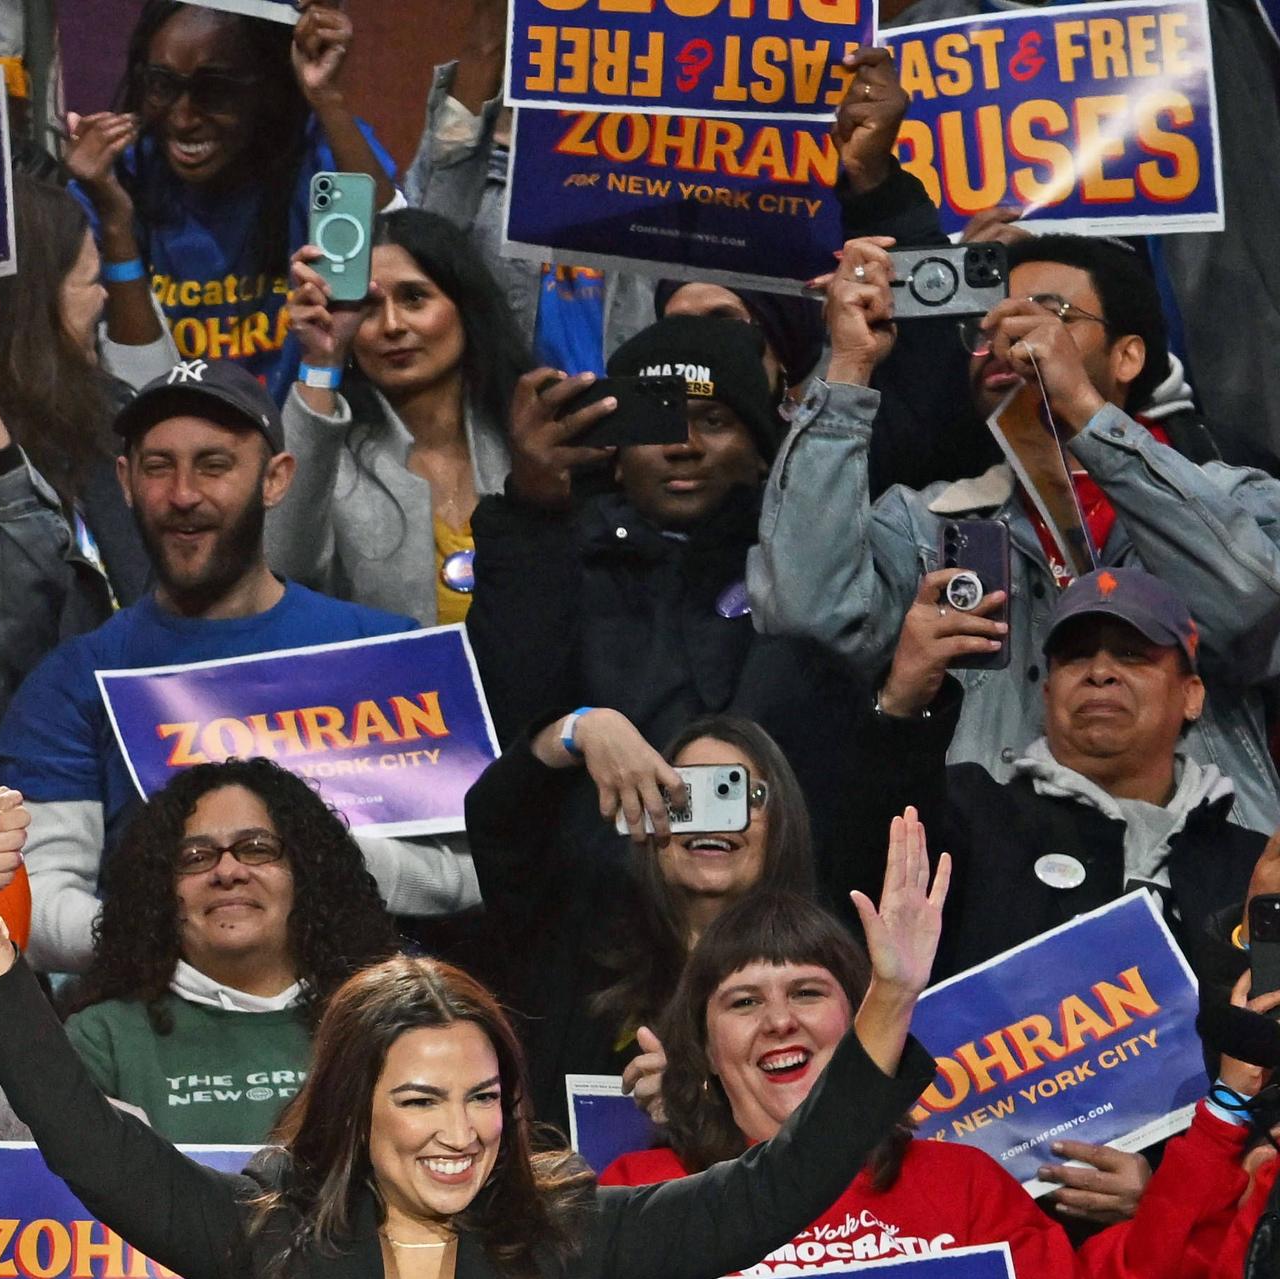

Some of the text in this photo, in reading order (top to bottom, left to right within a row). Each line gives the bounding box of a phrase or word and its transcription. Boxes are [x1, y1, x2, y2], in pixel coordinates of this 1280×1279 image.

[525, 26, 664, 97] FREE
[884, 14, 1190, 101] AST & FREE
[553, 109, 839, 187] ZOHRAN
[607, 172, 672, 198] NEW
[678, 182, 750, 209] YORK
[758, 194, 824, 218] CITY
[172, 291, 291, 360] OHR
[156, 691, 450, 767] ZOHRAN
[300, 748, 440, 778] YORK CITY
[910, 966, 1161, 1124] OHRAN
[166, 1074, 233, 1090] THE
[168, 1089, 242, 1106] NEW
[951, 1029, 1159, 1137] NEW YORK CITY
[1000, 1102, 1114, 1161] ZOHRANFORNYC.COM
[763, 1231, 956, 1262] MOCRATIC
[814, 1213, 860, 1241] York
